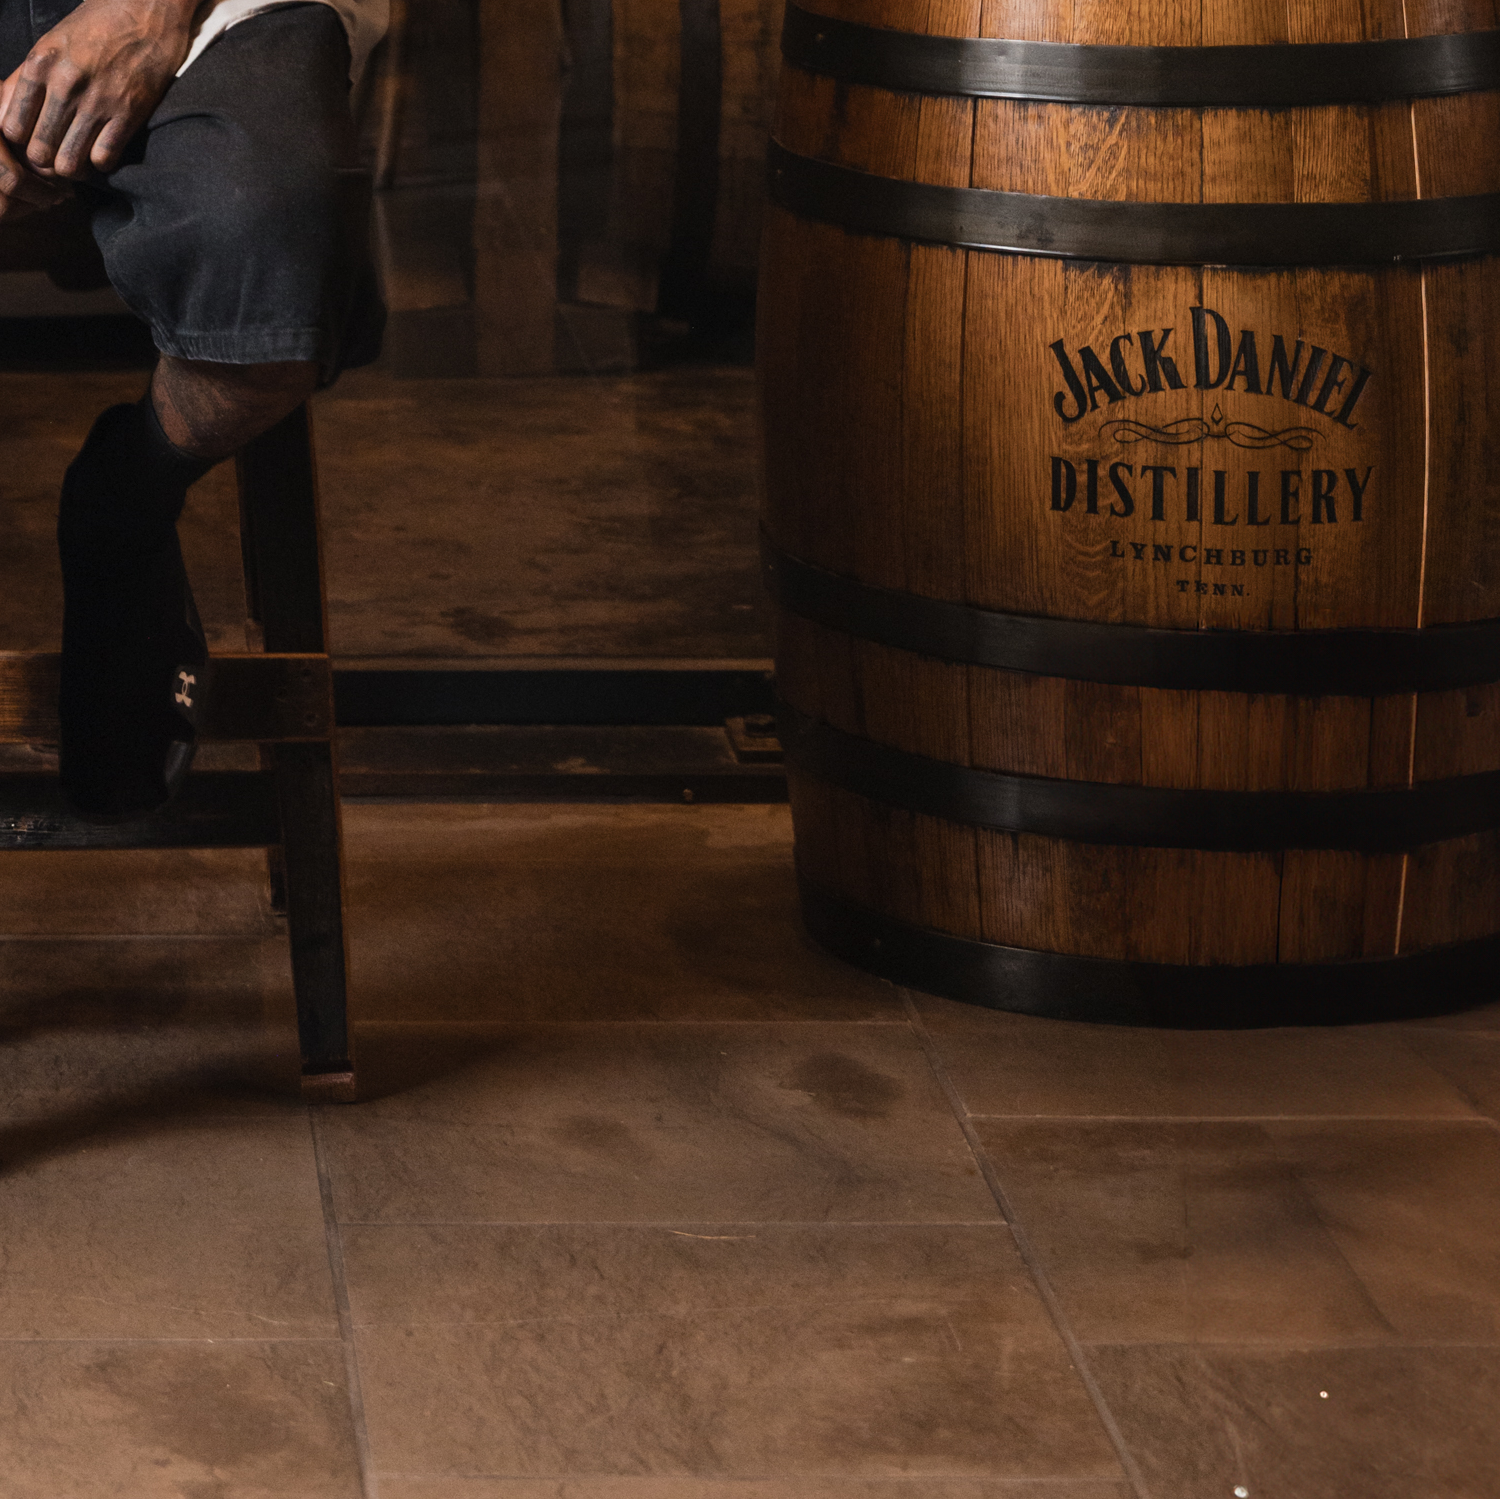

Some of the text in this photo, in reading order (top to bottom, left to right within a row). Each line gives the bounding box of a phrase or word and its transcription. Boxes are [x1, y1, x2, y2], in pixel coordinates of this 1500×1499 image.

[1049, 306, 1373, 431] JACK DANIEL
[1049, 455, 1376, 526] DISTILLERY
[1109, 539, 1314, 567] LYNCHBURG
[1176, 579, 1251, 597] TENN.
